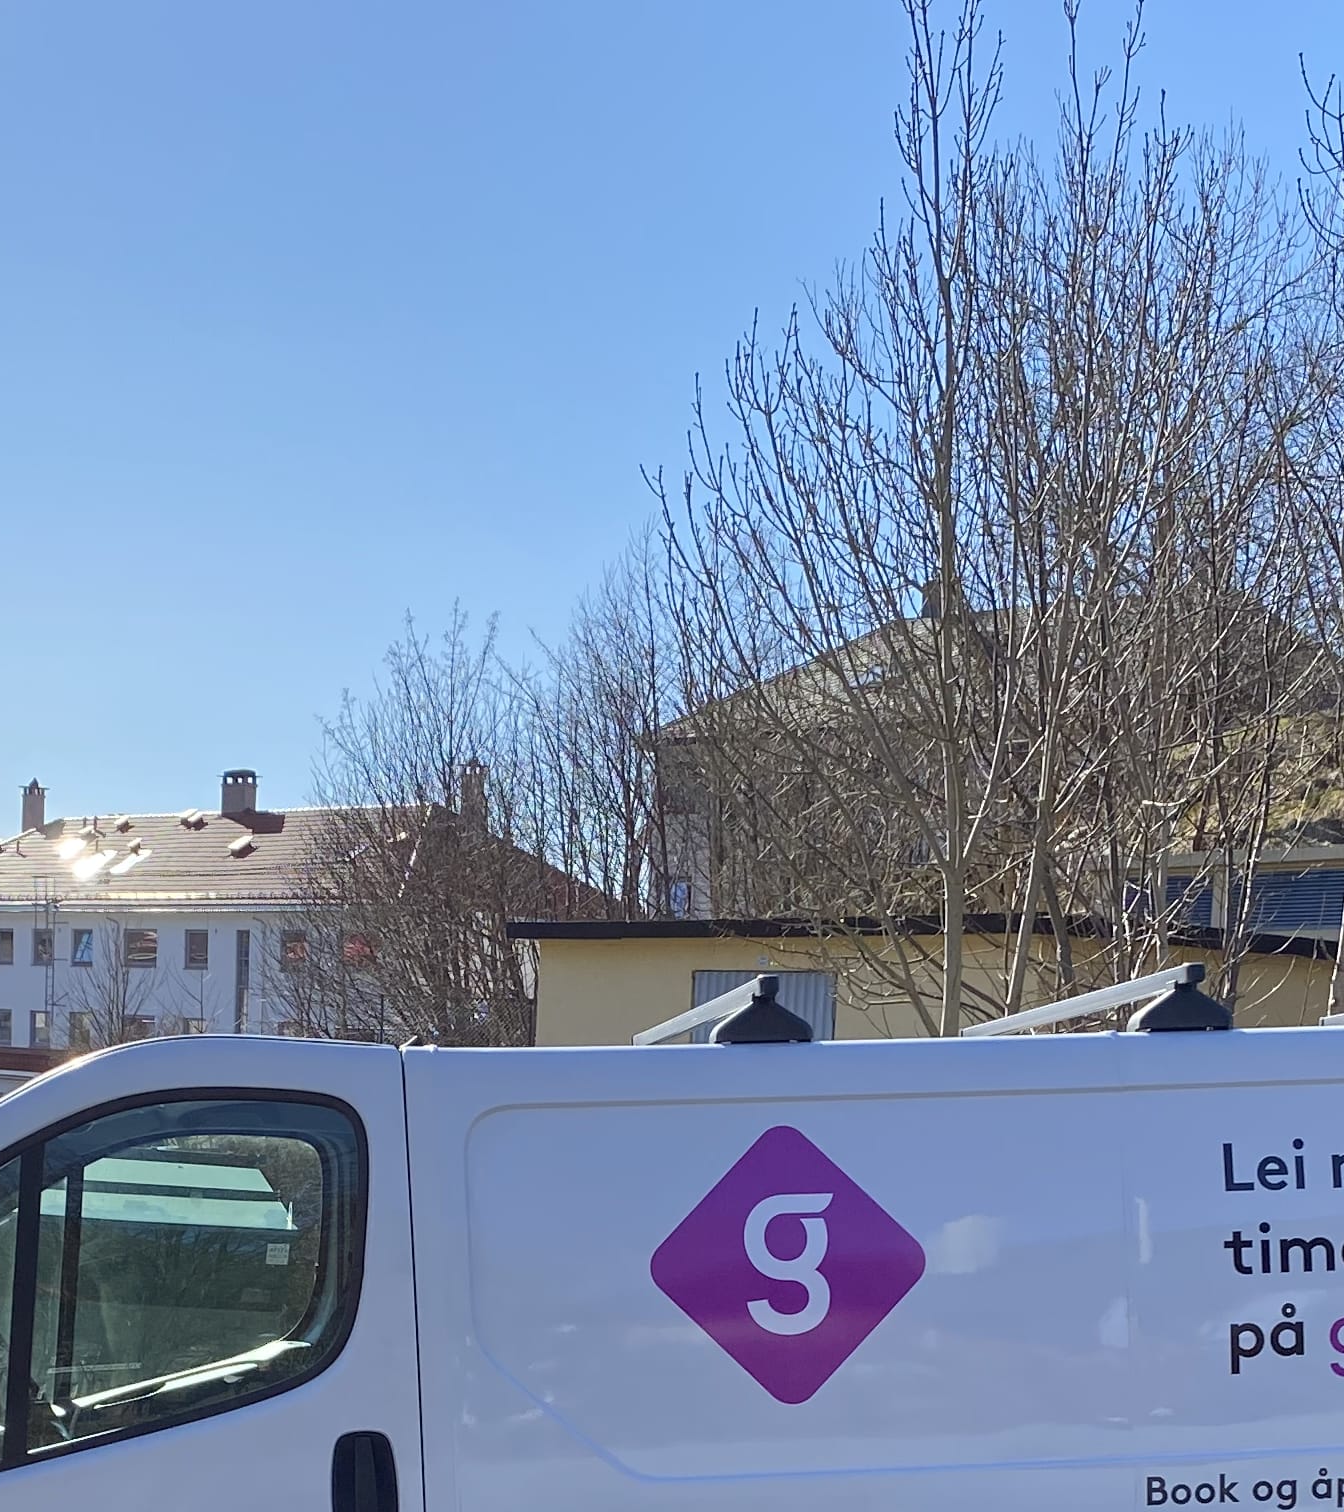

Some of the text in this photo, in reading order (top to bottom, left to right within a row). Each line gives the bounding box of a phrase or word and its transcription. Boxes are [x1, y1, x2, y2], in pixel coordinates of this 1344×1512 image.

[1223, 1138, 1305, 1192] Lei
[1230, 1302, 1306, 1375] på
[1146, 1470, 1239, 1506] Book
[1252, 1480, 1298, 1510] og
